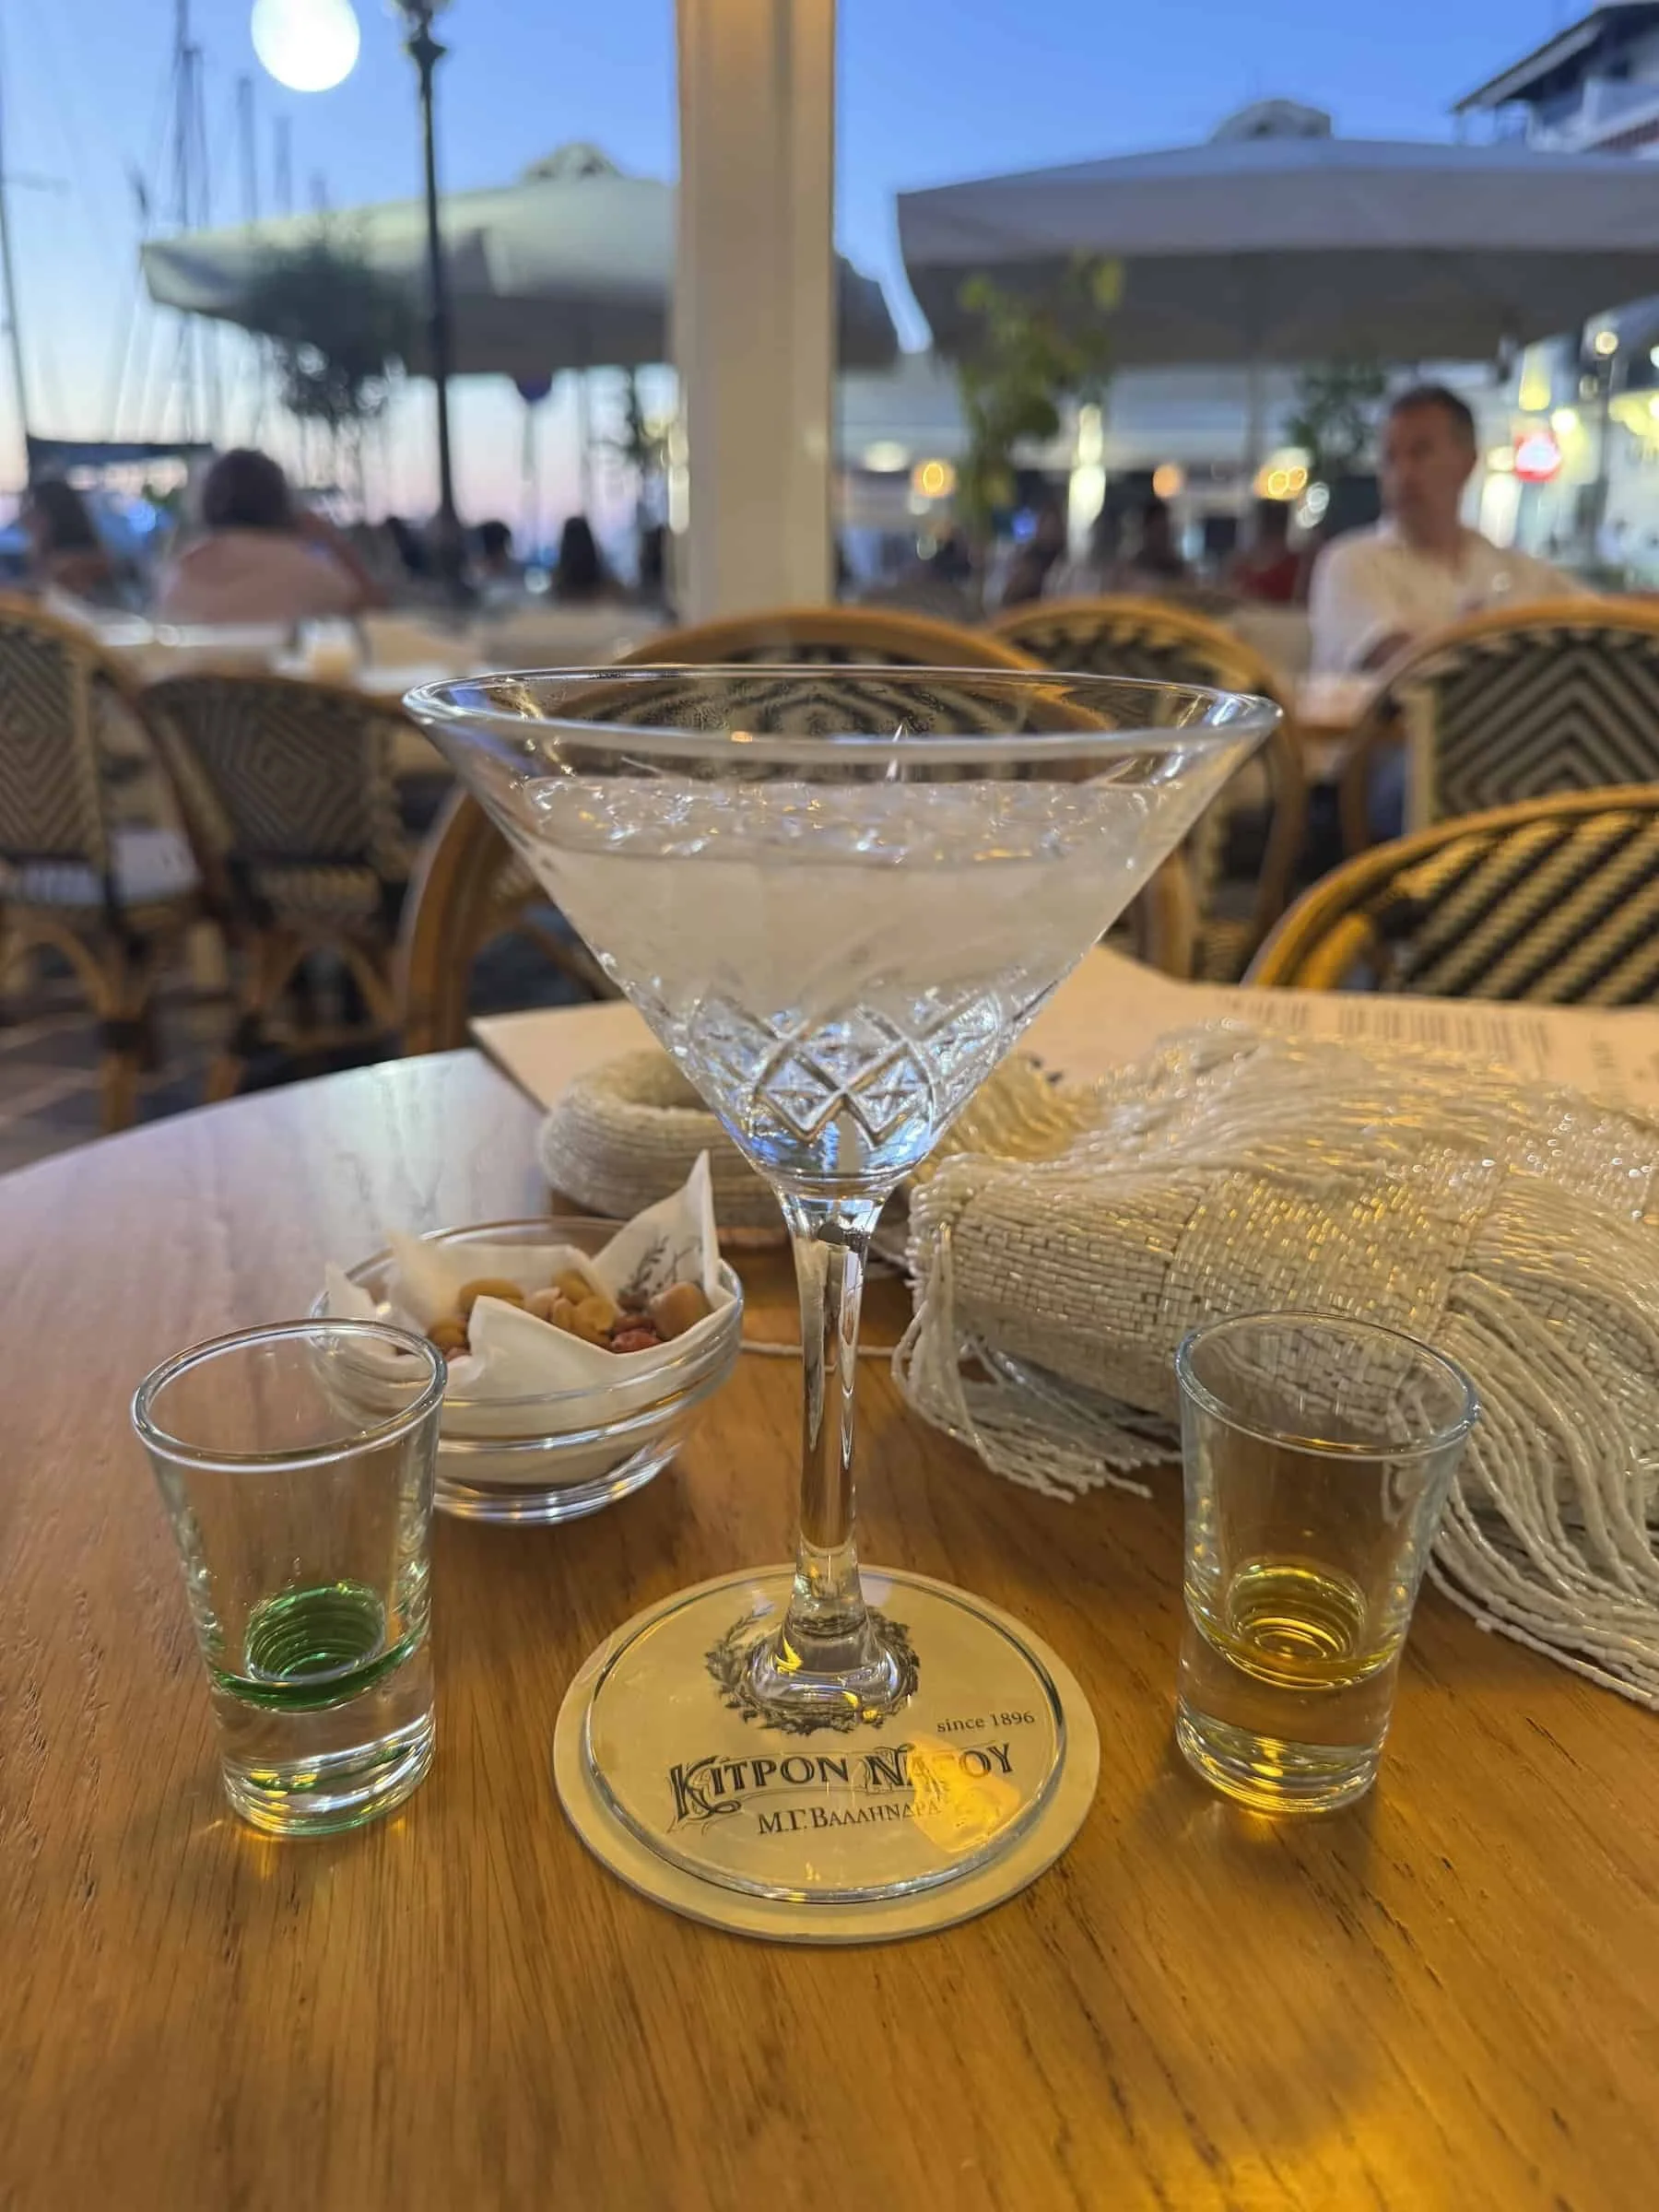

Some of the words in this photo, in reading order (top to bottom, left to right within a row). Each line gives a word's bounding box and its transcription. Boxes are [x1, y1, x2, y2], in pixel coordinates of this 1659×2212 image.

[936, 1716, 985, 1733] since
[990, 1712, 1035, 1728] 1896
[865, 1742, 1015, 1786] ΝΑΟΥ
